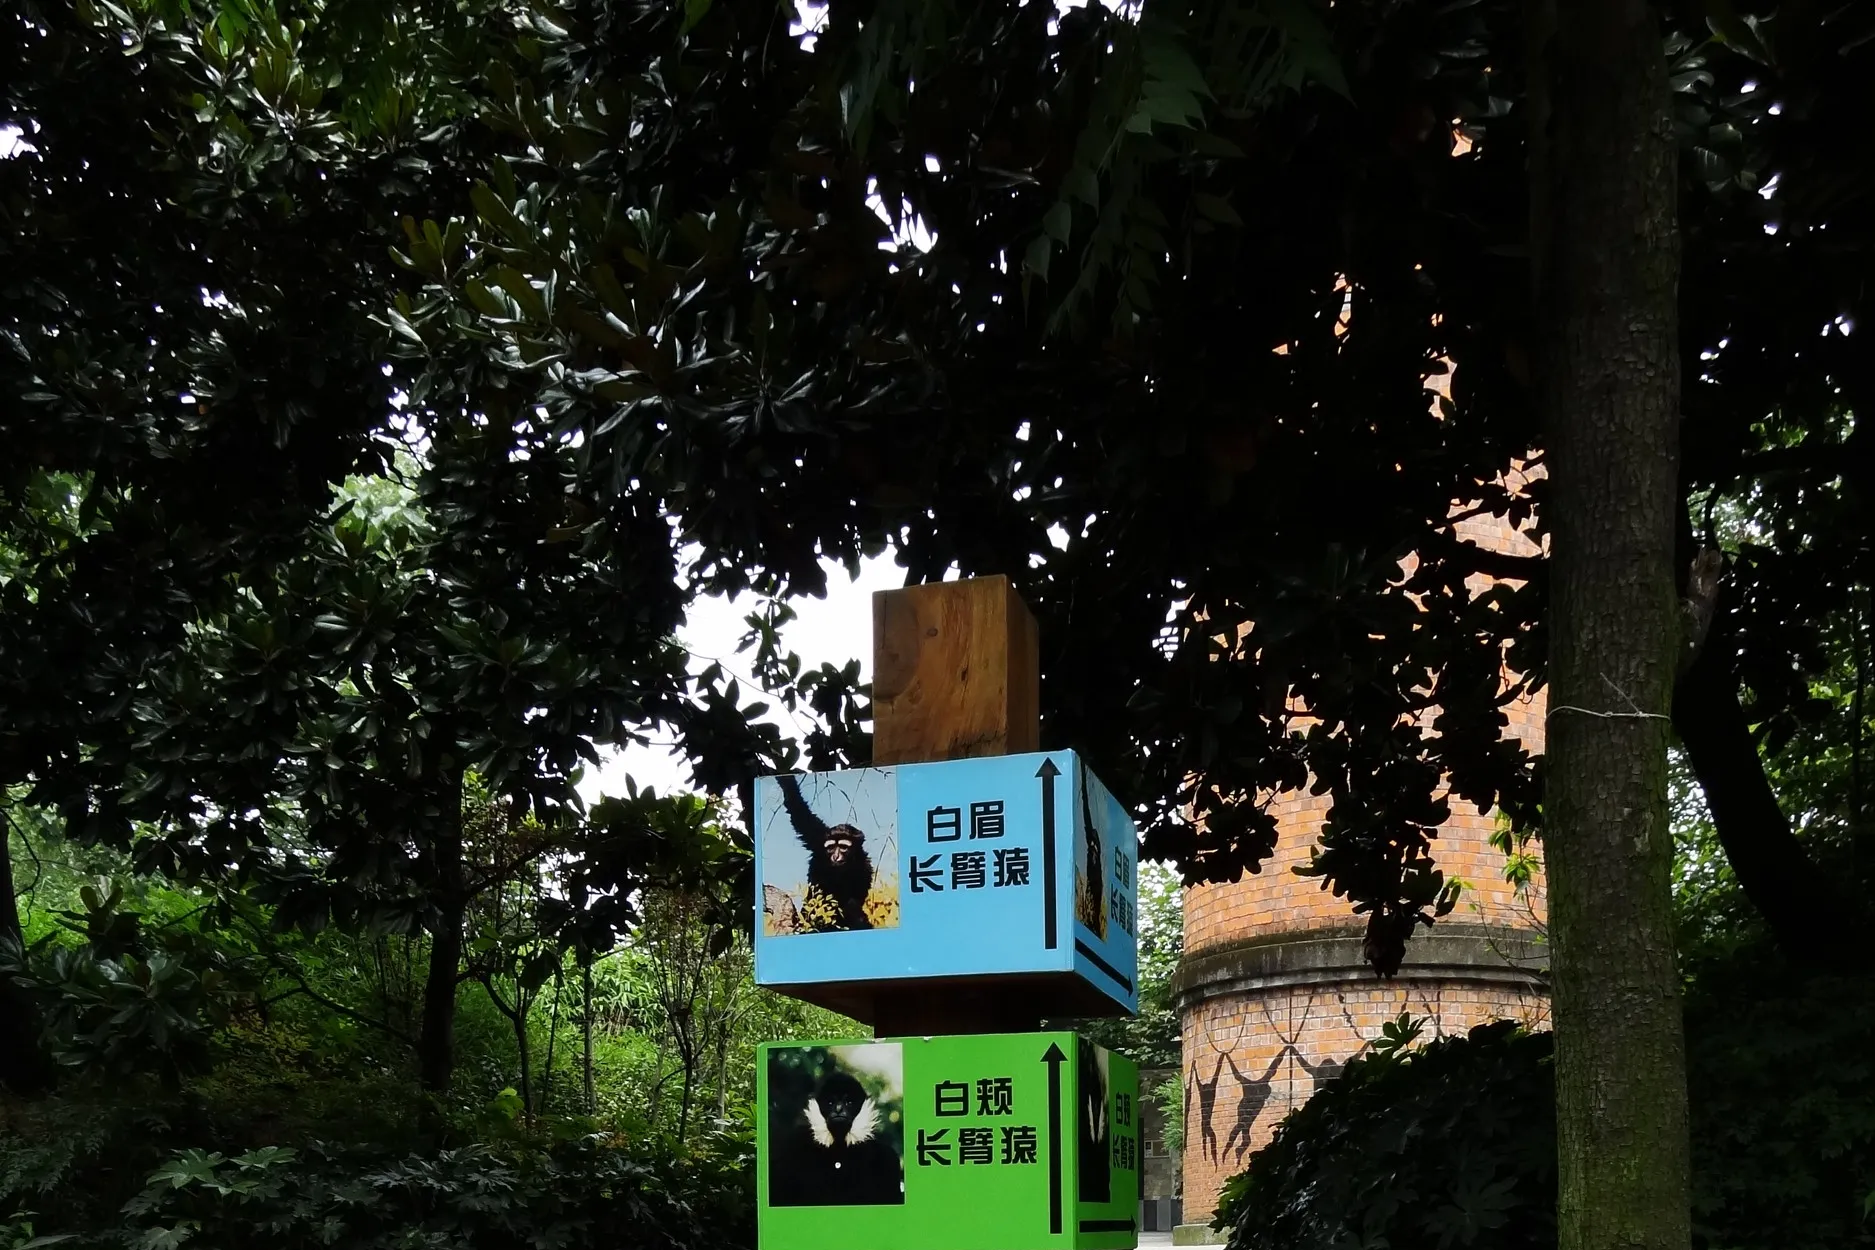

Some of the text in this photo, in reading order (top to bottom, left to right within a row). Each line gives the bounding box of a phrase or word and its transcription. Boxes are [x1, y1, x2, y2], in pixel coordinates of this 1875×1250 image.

[927, 800, 1004, 843] 白眉
[908, 847, 1030, 893] 长臂猿
[934, 1077, 1013, 1117] 白颊
[916, 1126, 1038, 1167] 长臂猿
